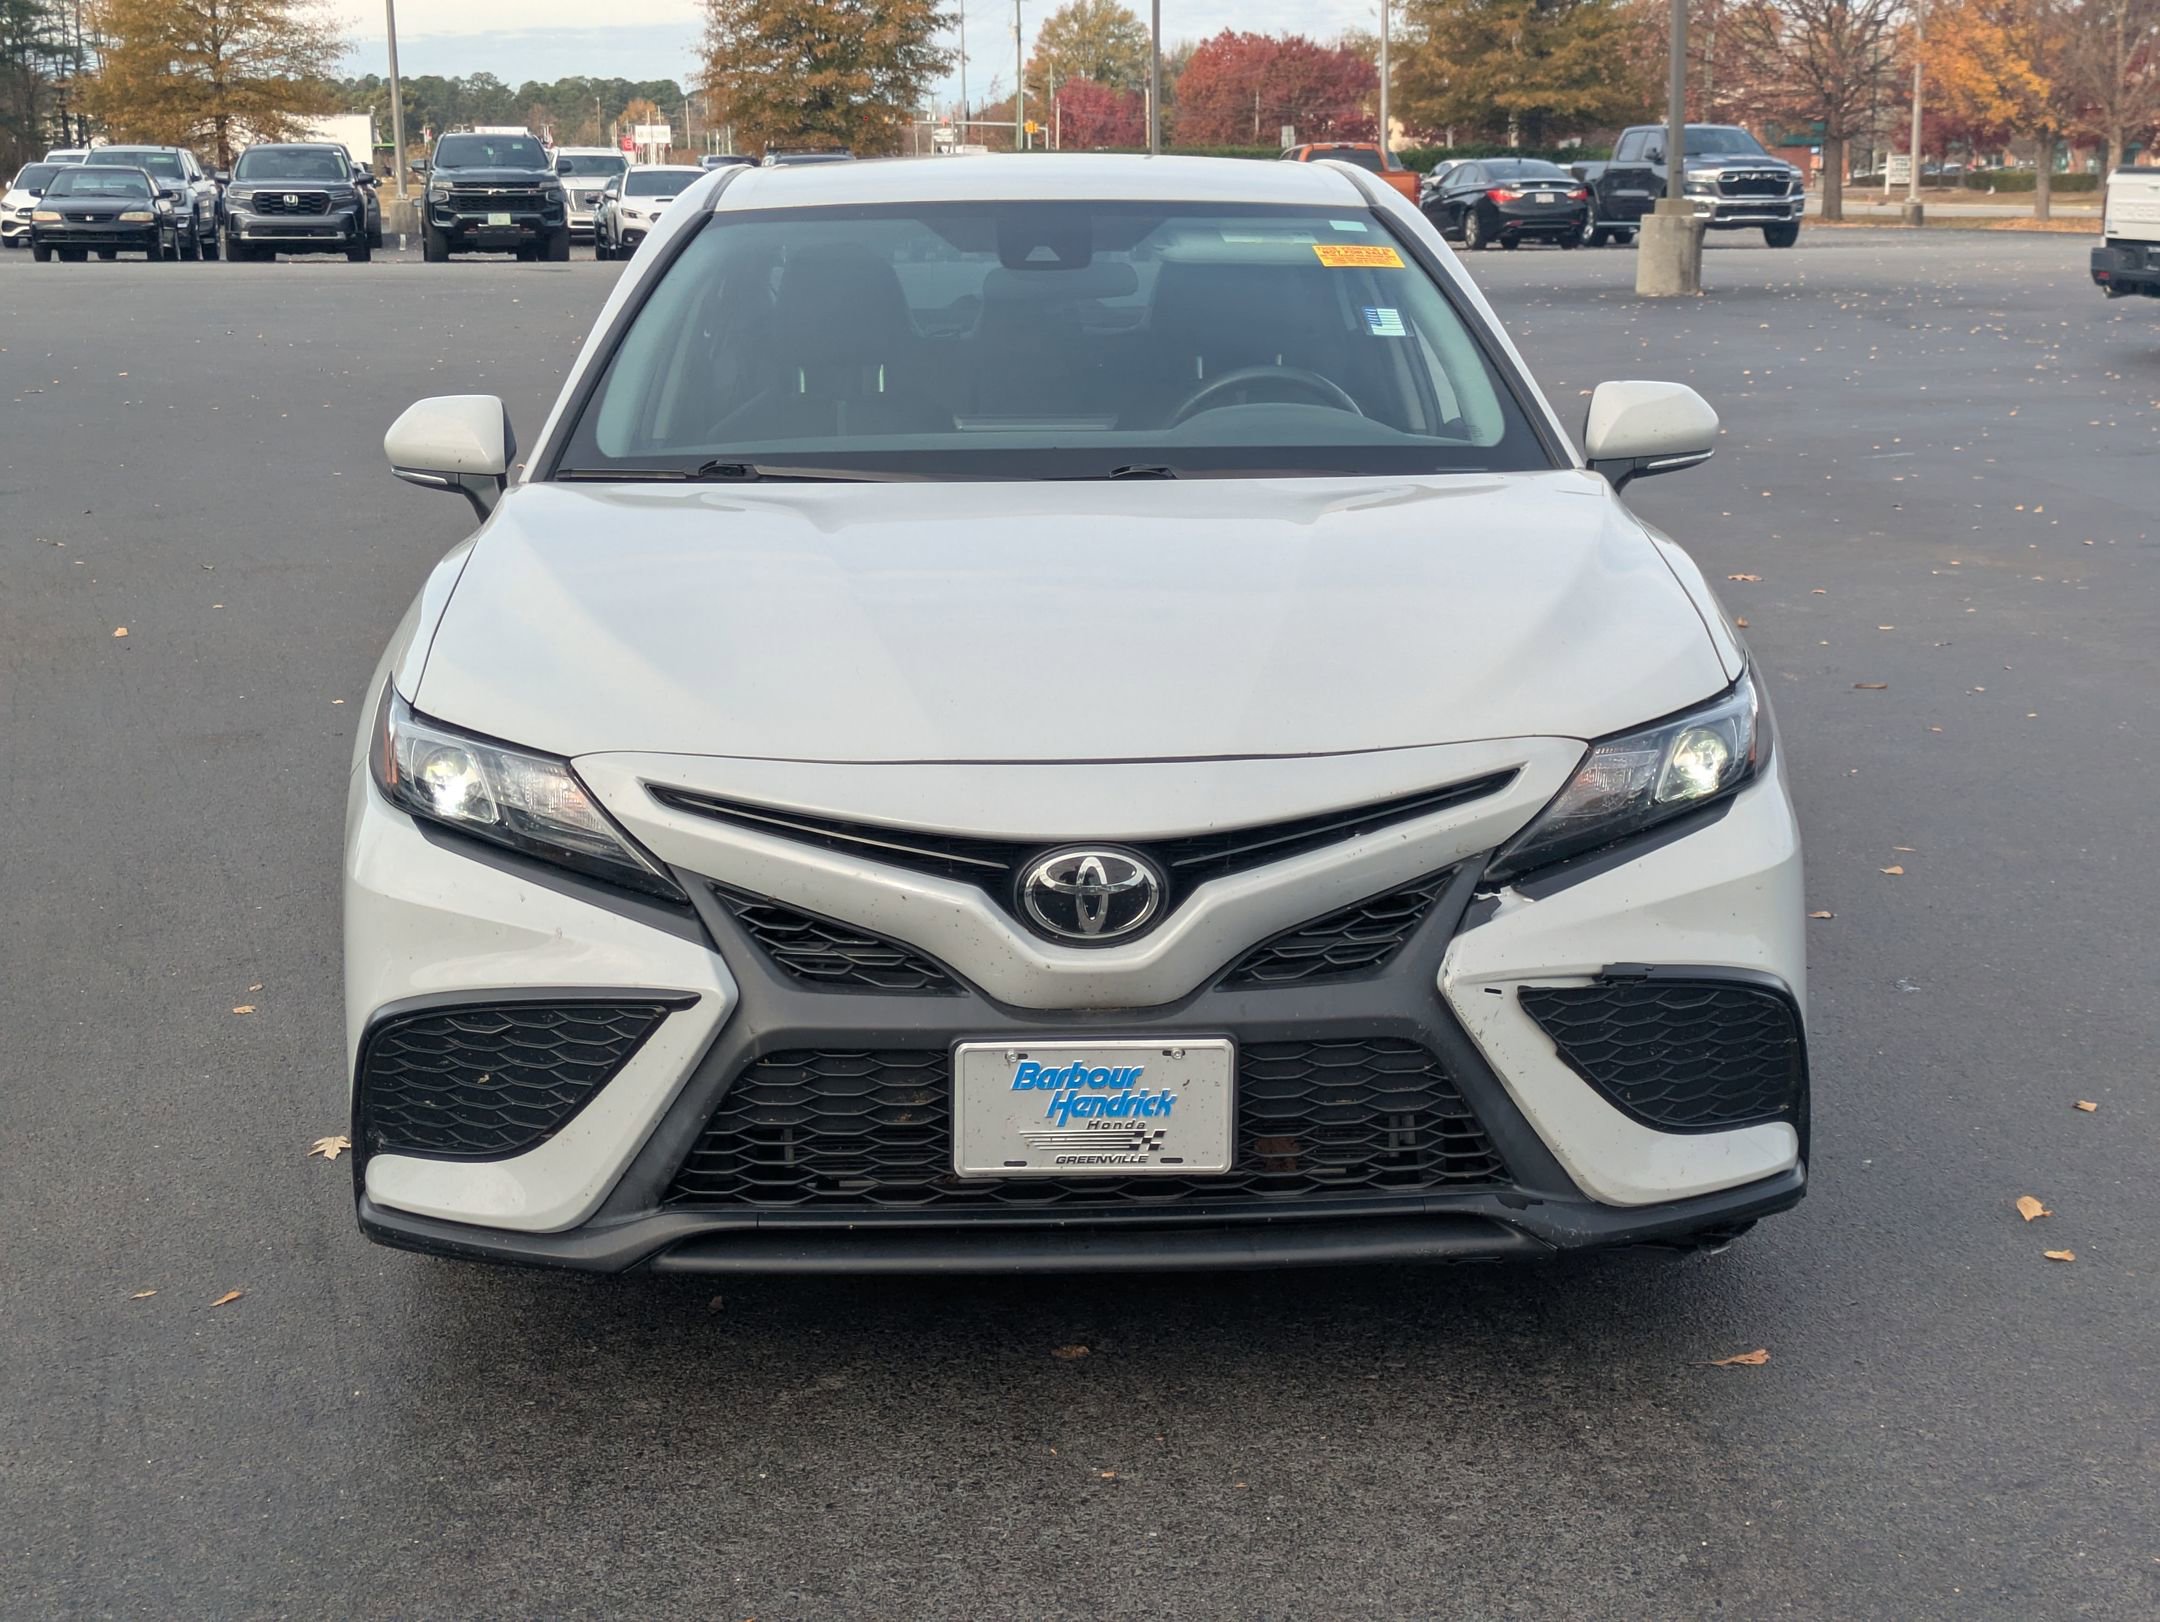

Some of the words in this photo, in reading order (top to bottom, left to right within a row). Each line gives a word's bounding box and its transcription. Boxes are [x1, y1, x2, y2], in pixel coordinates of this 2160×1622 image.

[1011, 1060, 1144, 1090] Barbour
[1045, 1088, 1178, 1127] Hendrick
[1087, 1119, 1146, 1130] Honda
[1055, 1154, 1149, 1165] GREENVILLE
